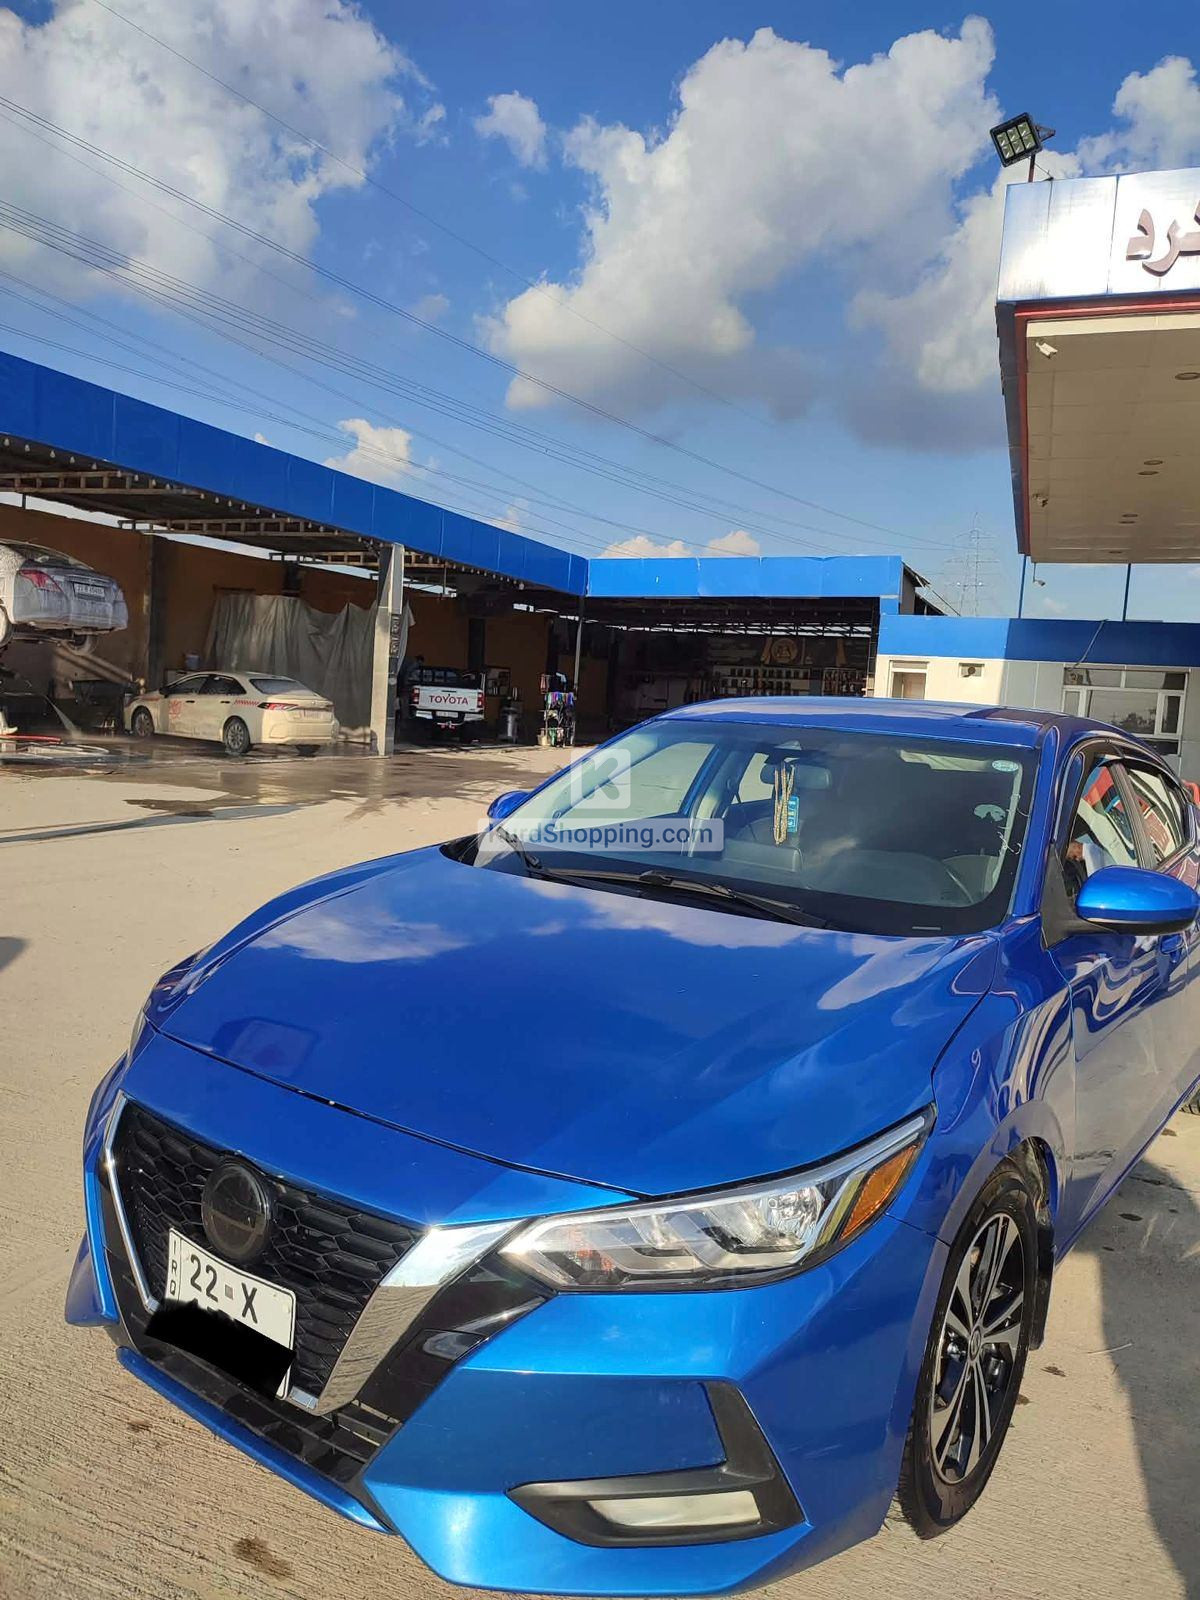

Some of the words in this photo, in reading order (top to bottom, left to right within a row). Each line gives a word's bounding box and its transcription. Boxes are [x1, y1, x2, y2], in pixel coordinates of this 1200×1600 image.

[429, 695, 468, 704] TOYOTA
[190, 1254, 219, 1303] 22
[241, 1282, 258, 1324] X
